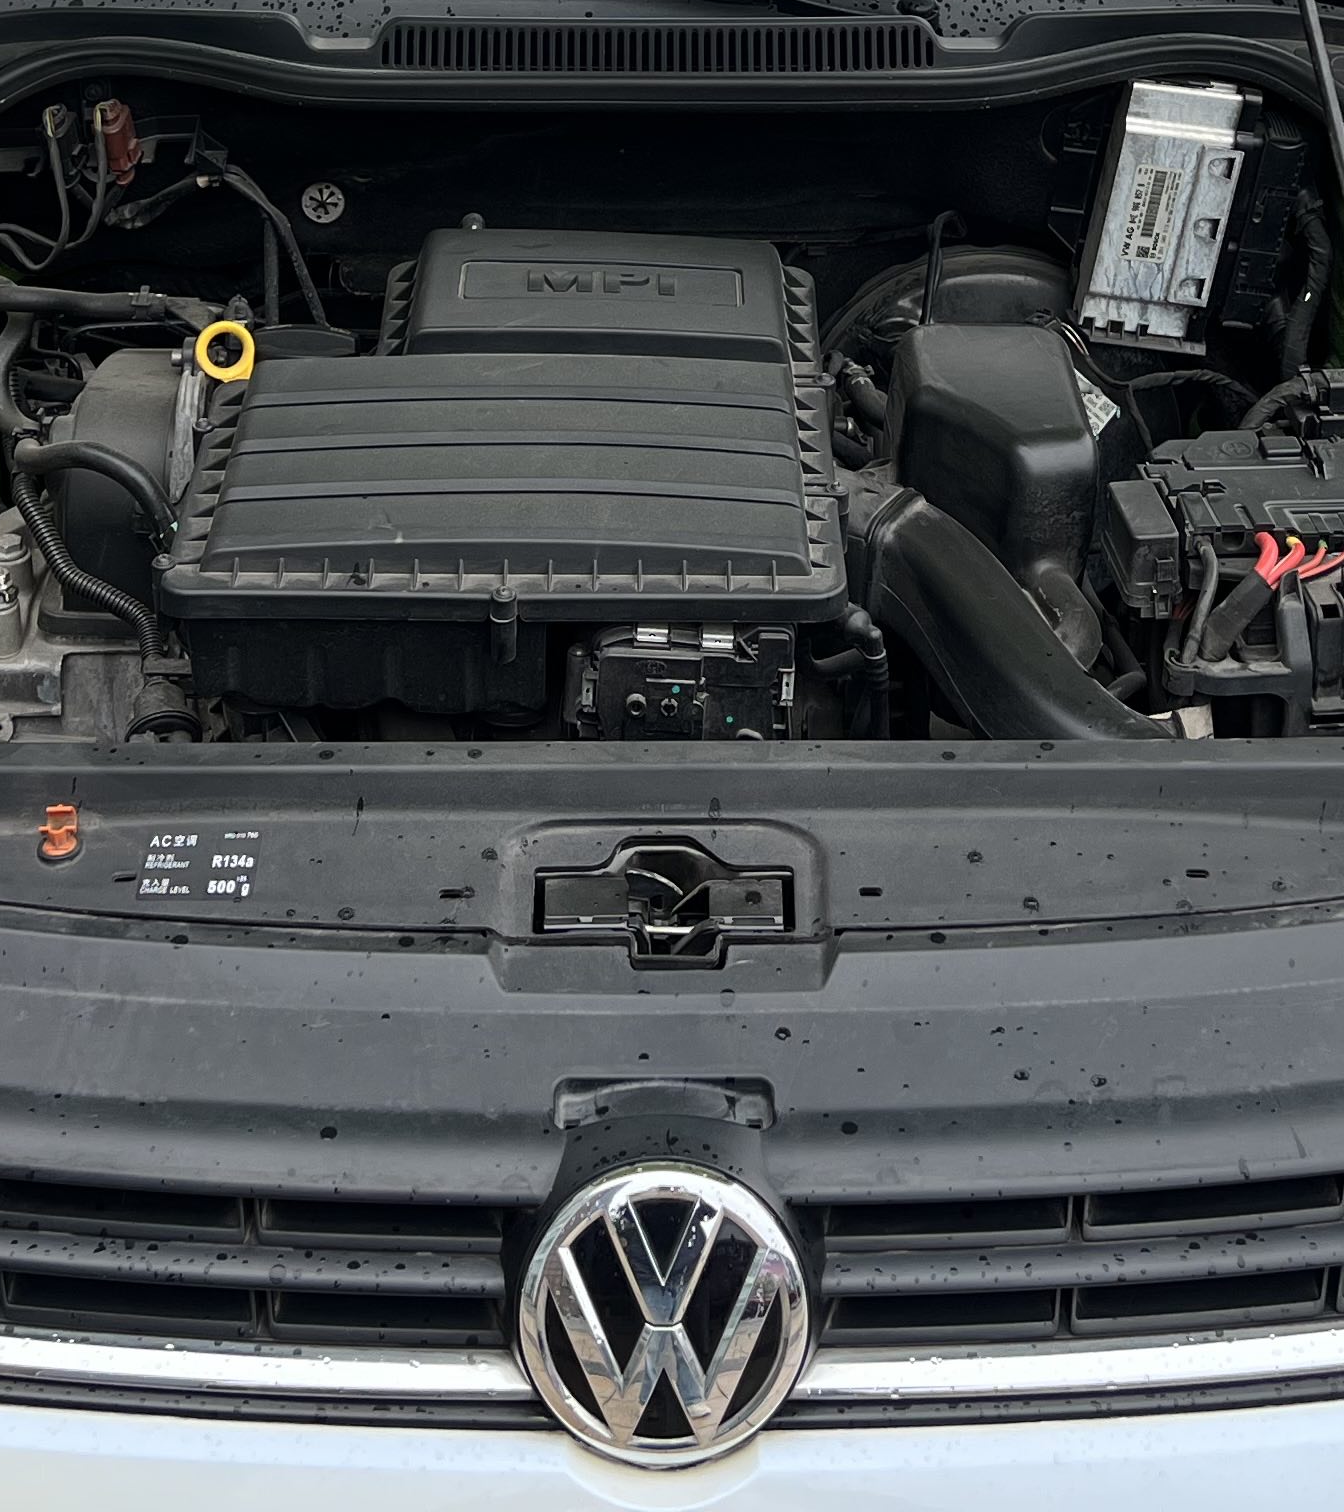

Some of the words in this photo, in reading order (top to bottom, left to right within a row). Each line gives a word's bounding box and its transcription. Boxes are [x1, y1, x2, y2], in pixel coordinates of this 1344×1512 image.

[527, 269, 676, 296] MPI
[212, 854, 254, 868] R134a
[207, 879, 236, 894] 500
[528, 1170, 798, 1456] VW
